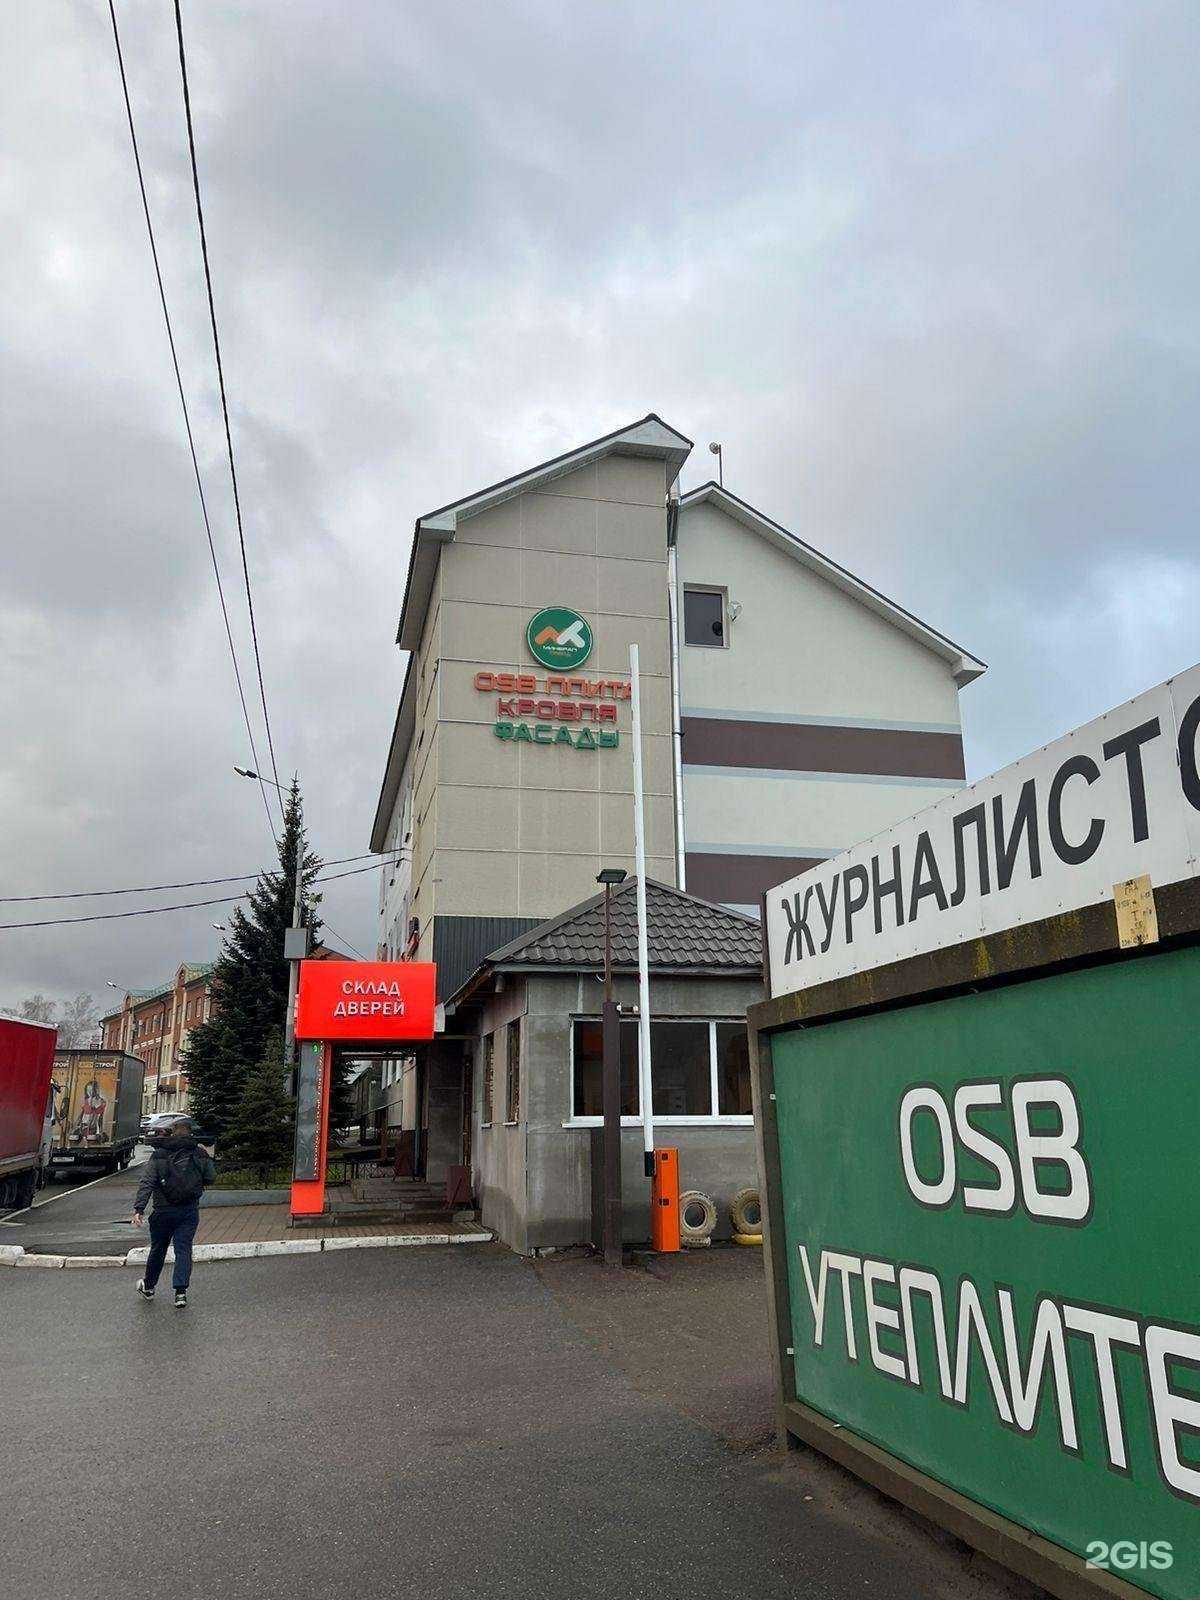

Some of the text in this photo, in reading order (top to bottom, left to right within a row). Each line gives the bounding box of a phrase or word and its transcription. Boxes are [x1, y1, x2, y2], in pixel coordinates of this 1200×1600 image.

[474, 672, 536, 694] OSB
[497, 698, 617, 722] КРОВЛЯ
[495, 722, 620, 750] ФАСАДЫ
[342, 980, 401, 996] СКЛАД
[333, 999, 405, 1016] ДВЕРЕЙ
[898, 1078, 1092, 1222] OSB
